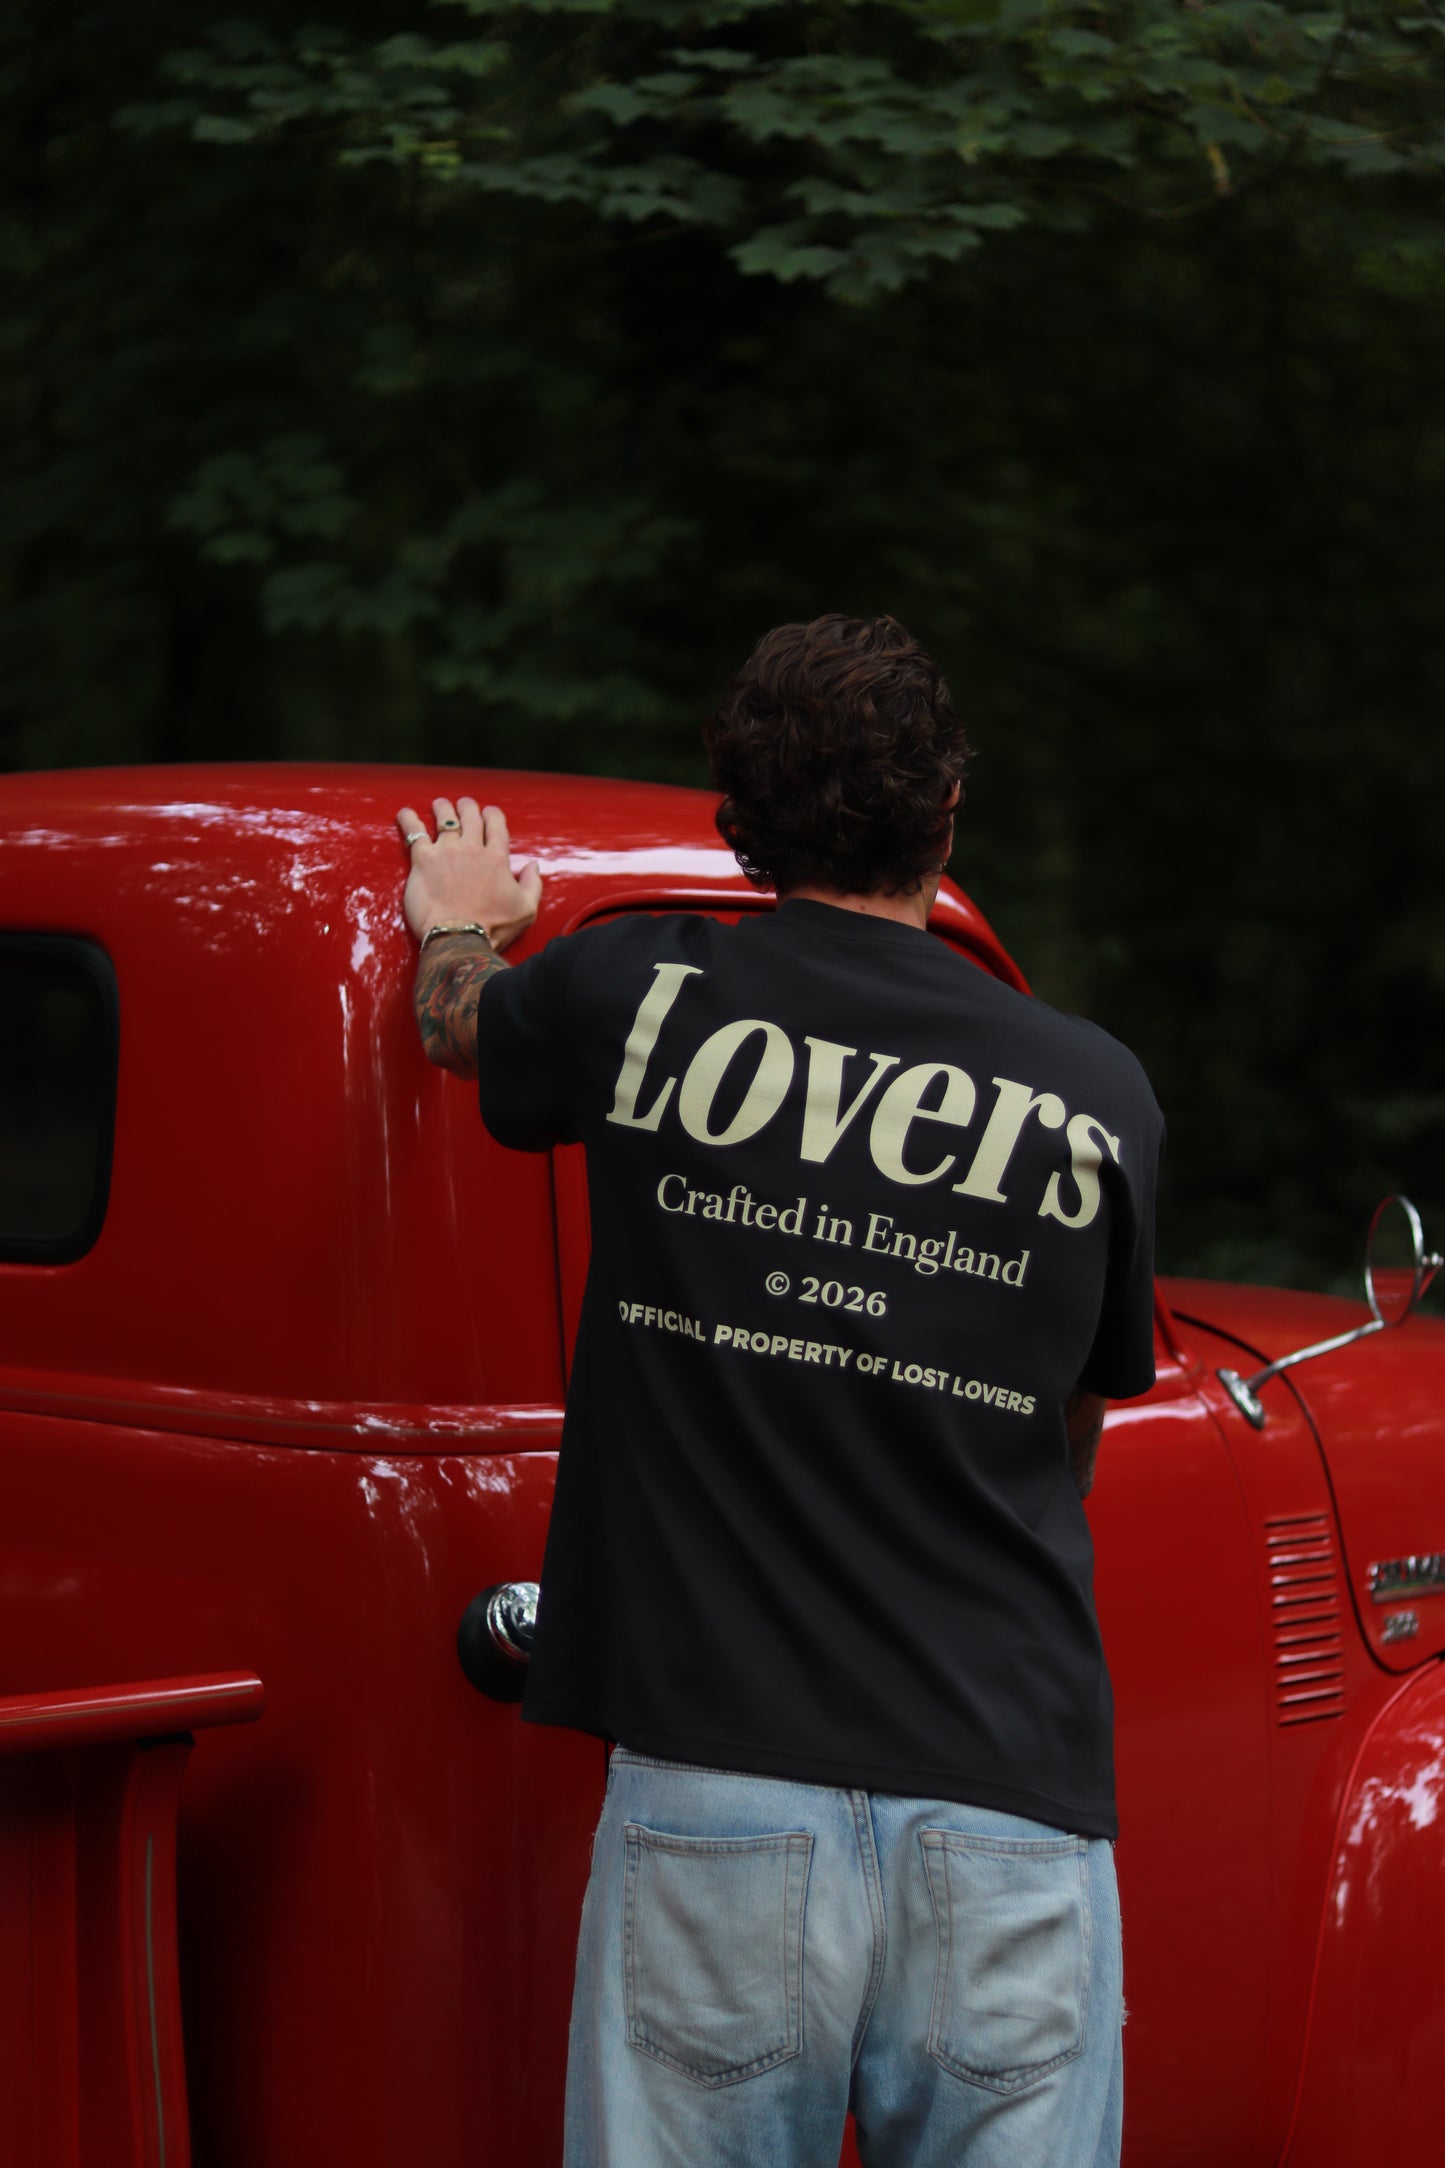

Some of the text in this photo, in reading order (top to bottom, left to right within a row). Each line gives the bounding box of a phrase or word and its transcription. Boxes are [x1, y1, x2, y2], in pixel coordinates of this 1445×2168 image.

[605, 962, 1122, 1229] Lovers
[656, 1173, 1031, 1288] Crafted in England
[797, 1276, 887, 1317] 2026
[618, 1300, 1037, 1415] OFFICIAL PROPERTY OF LOST LOVERS
